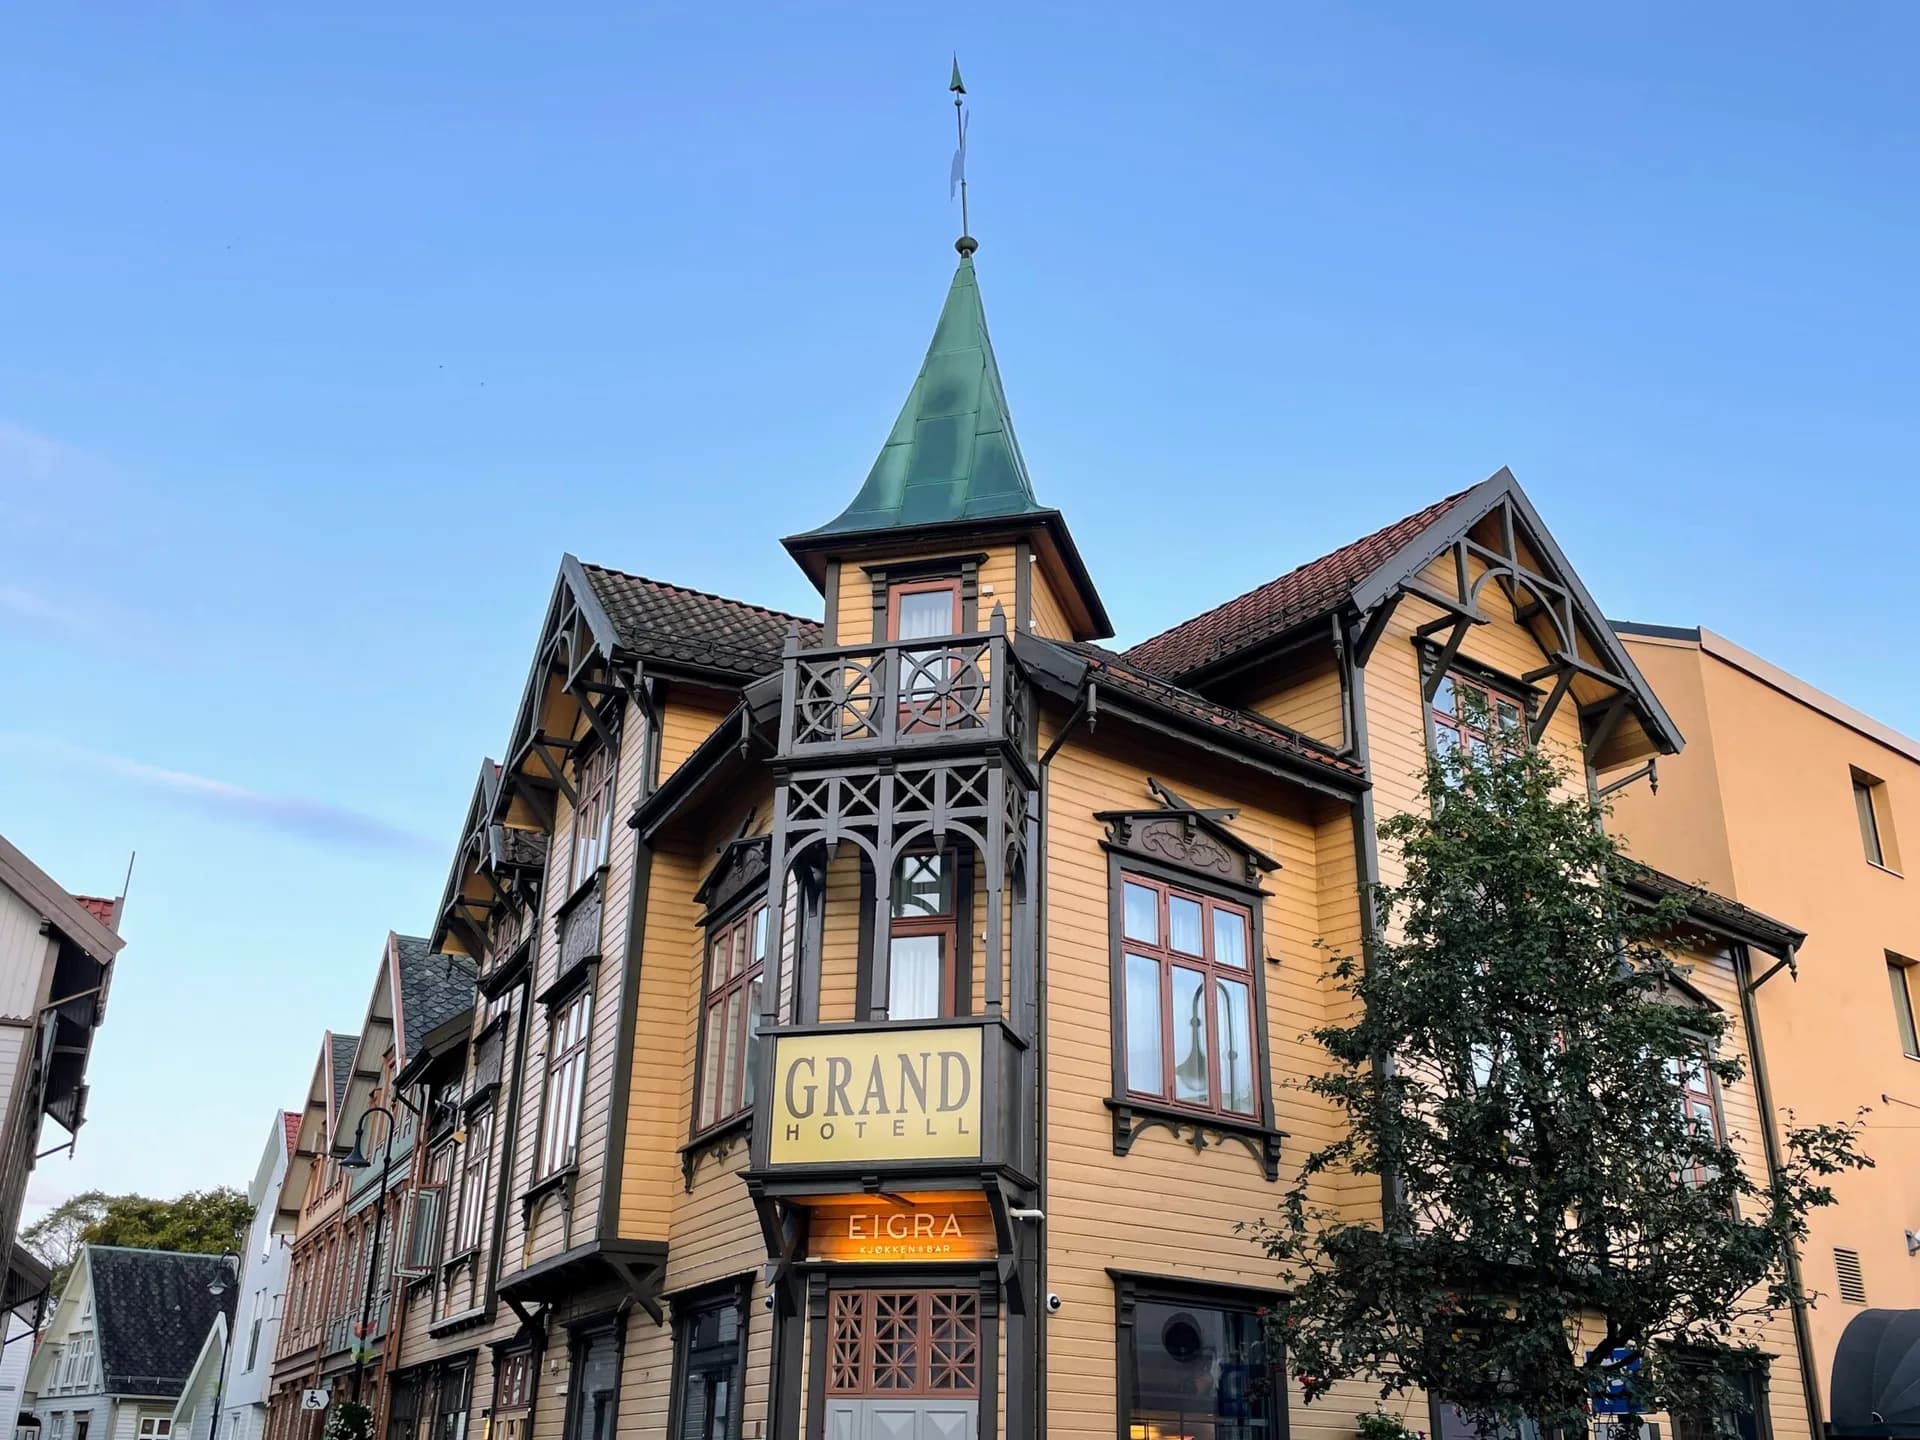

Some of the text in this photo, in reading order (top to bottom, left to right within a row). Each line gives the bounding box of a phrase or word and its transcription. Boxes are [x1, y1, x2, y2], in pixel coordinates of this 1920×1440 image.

[785, 1051, 971, 1119] GRAND
[786, 1117, 970, 1141] HOTELL
[848, 1213, 962, 1239] EIGRA
